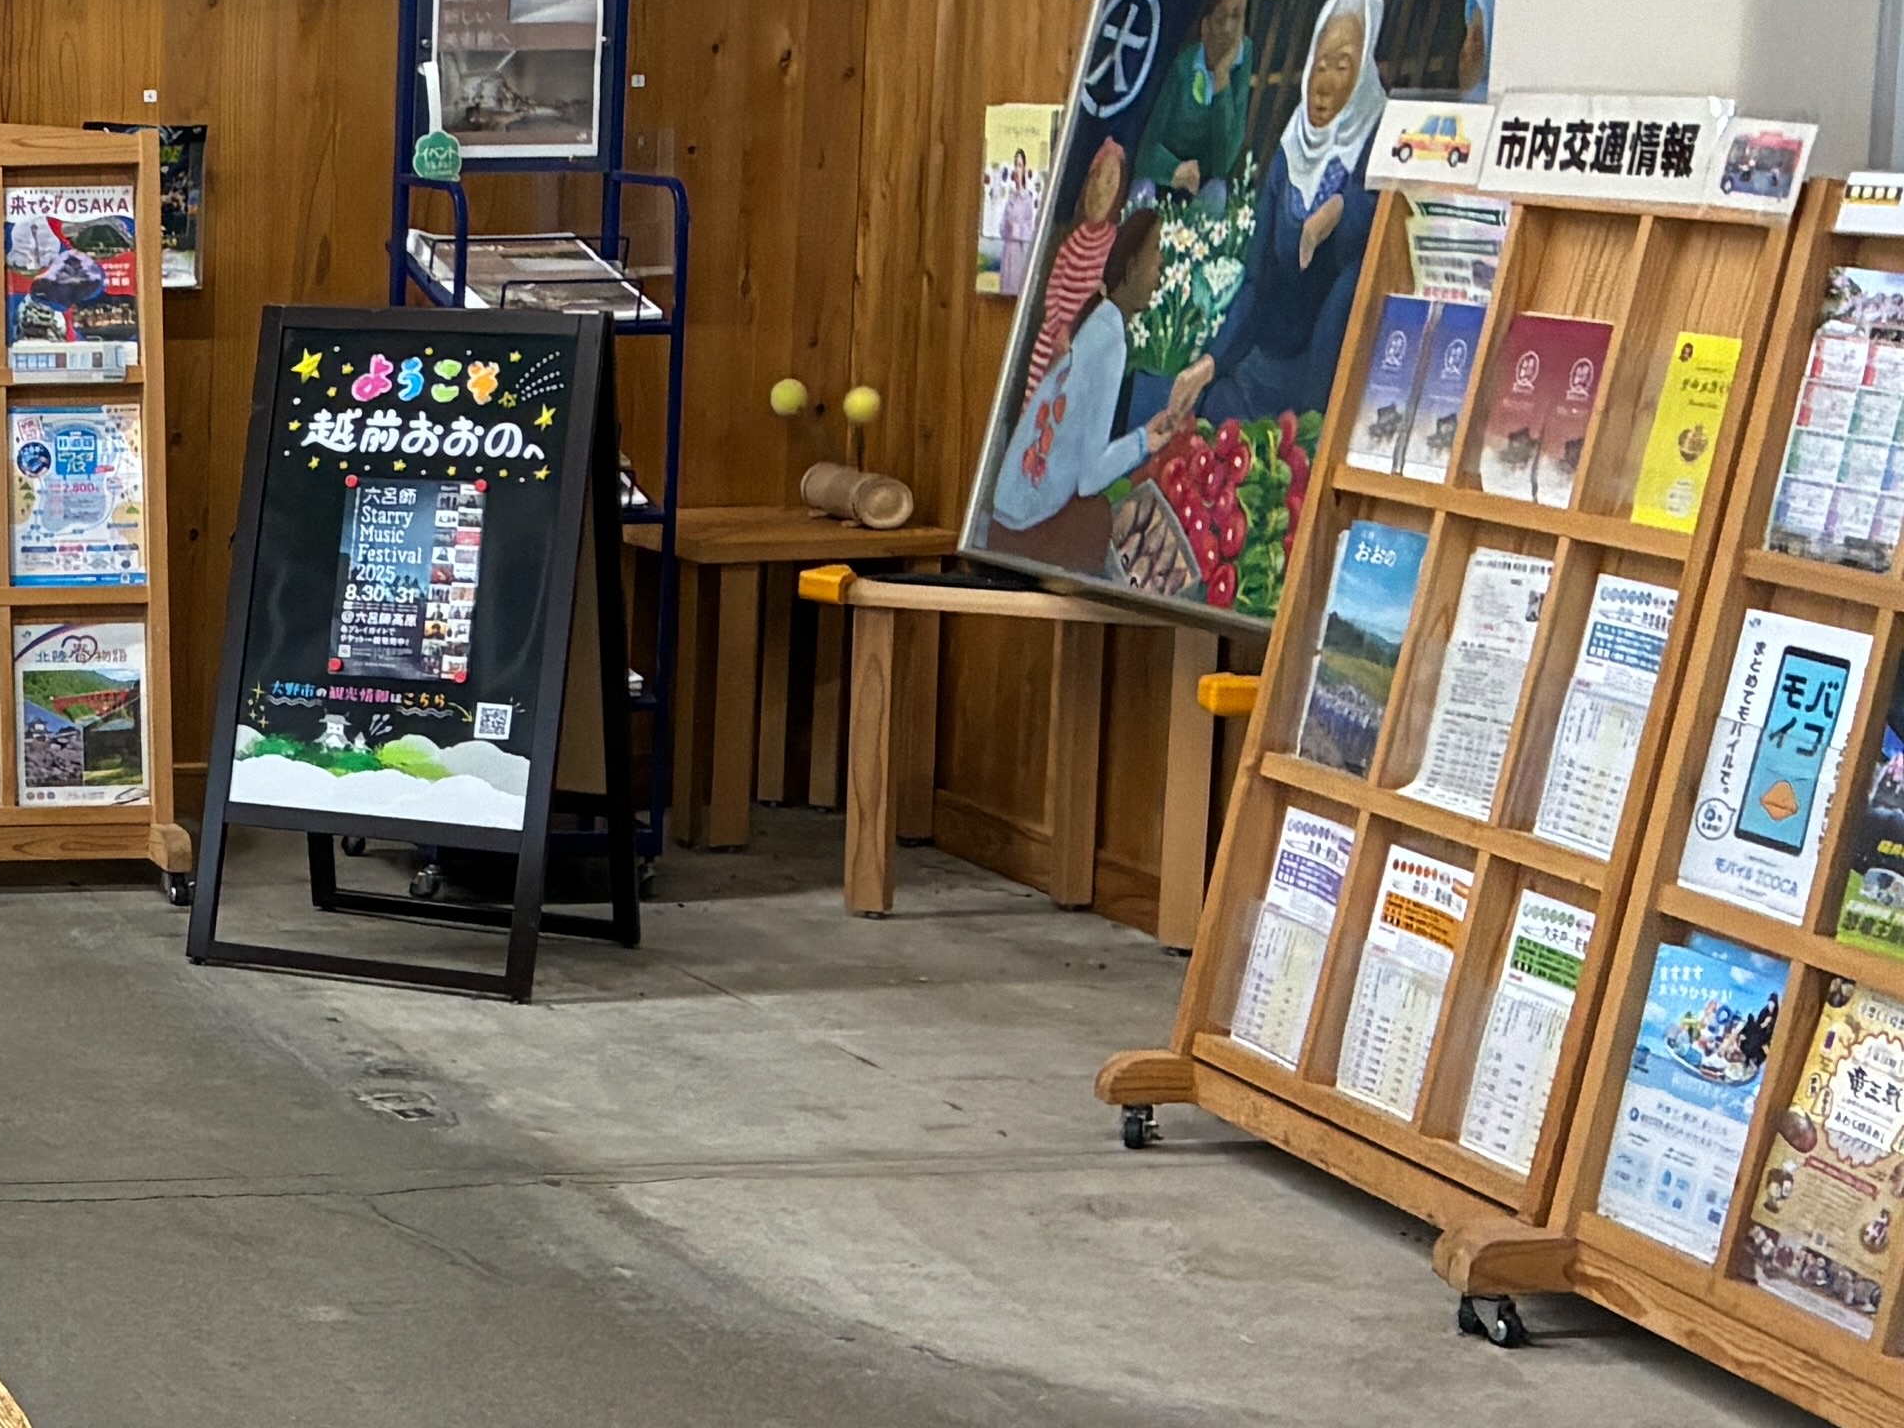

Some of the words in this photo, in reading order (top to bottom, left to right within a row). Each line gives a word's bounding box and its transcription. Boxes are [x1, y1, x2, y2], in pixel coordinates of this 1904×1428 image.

[1086, 4, 1146, 92] 大
[1495, 115, 1702, 179] 市内交通情報
[65, 197, 130, 215] OSAKA
[351, 353, 501, 405] ようこそ
[300, 408, 546, 461] 越前おおのへ
[363, 486, 417, 505] 六呂師
[360, 505, 414, 529] Starry
[359, 524, 405, 544] Music
[357, 543, 422, 565] Festival
[355, 563, 397, 584] 2025
[345, 583, 385, 603] 8.30
[395, 587, 417, 604] 31
[1781, 672, 1840, 720] モバ
[1769, 716, 1827, 758] イコ
[1754, 864, 1799, 897] ICOCA
